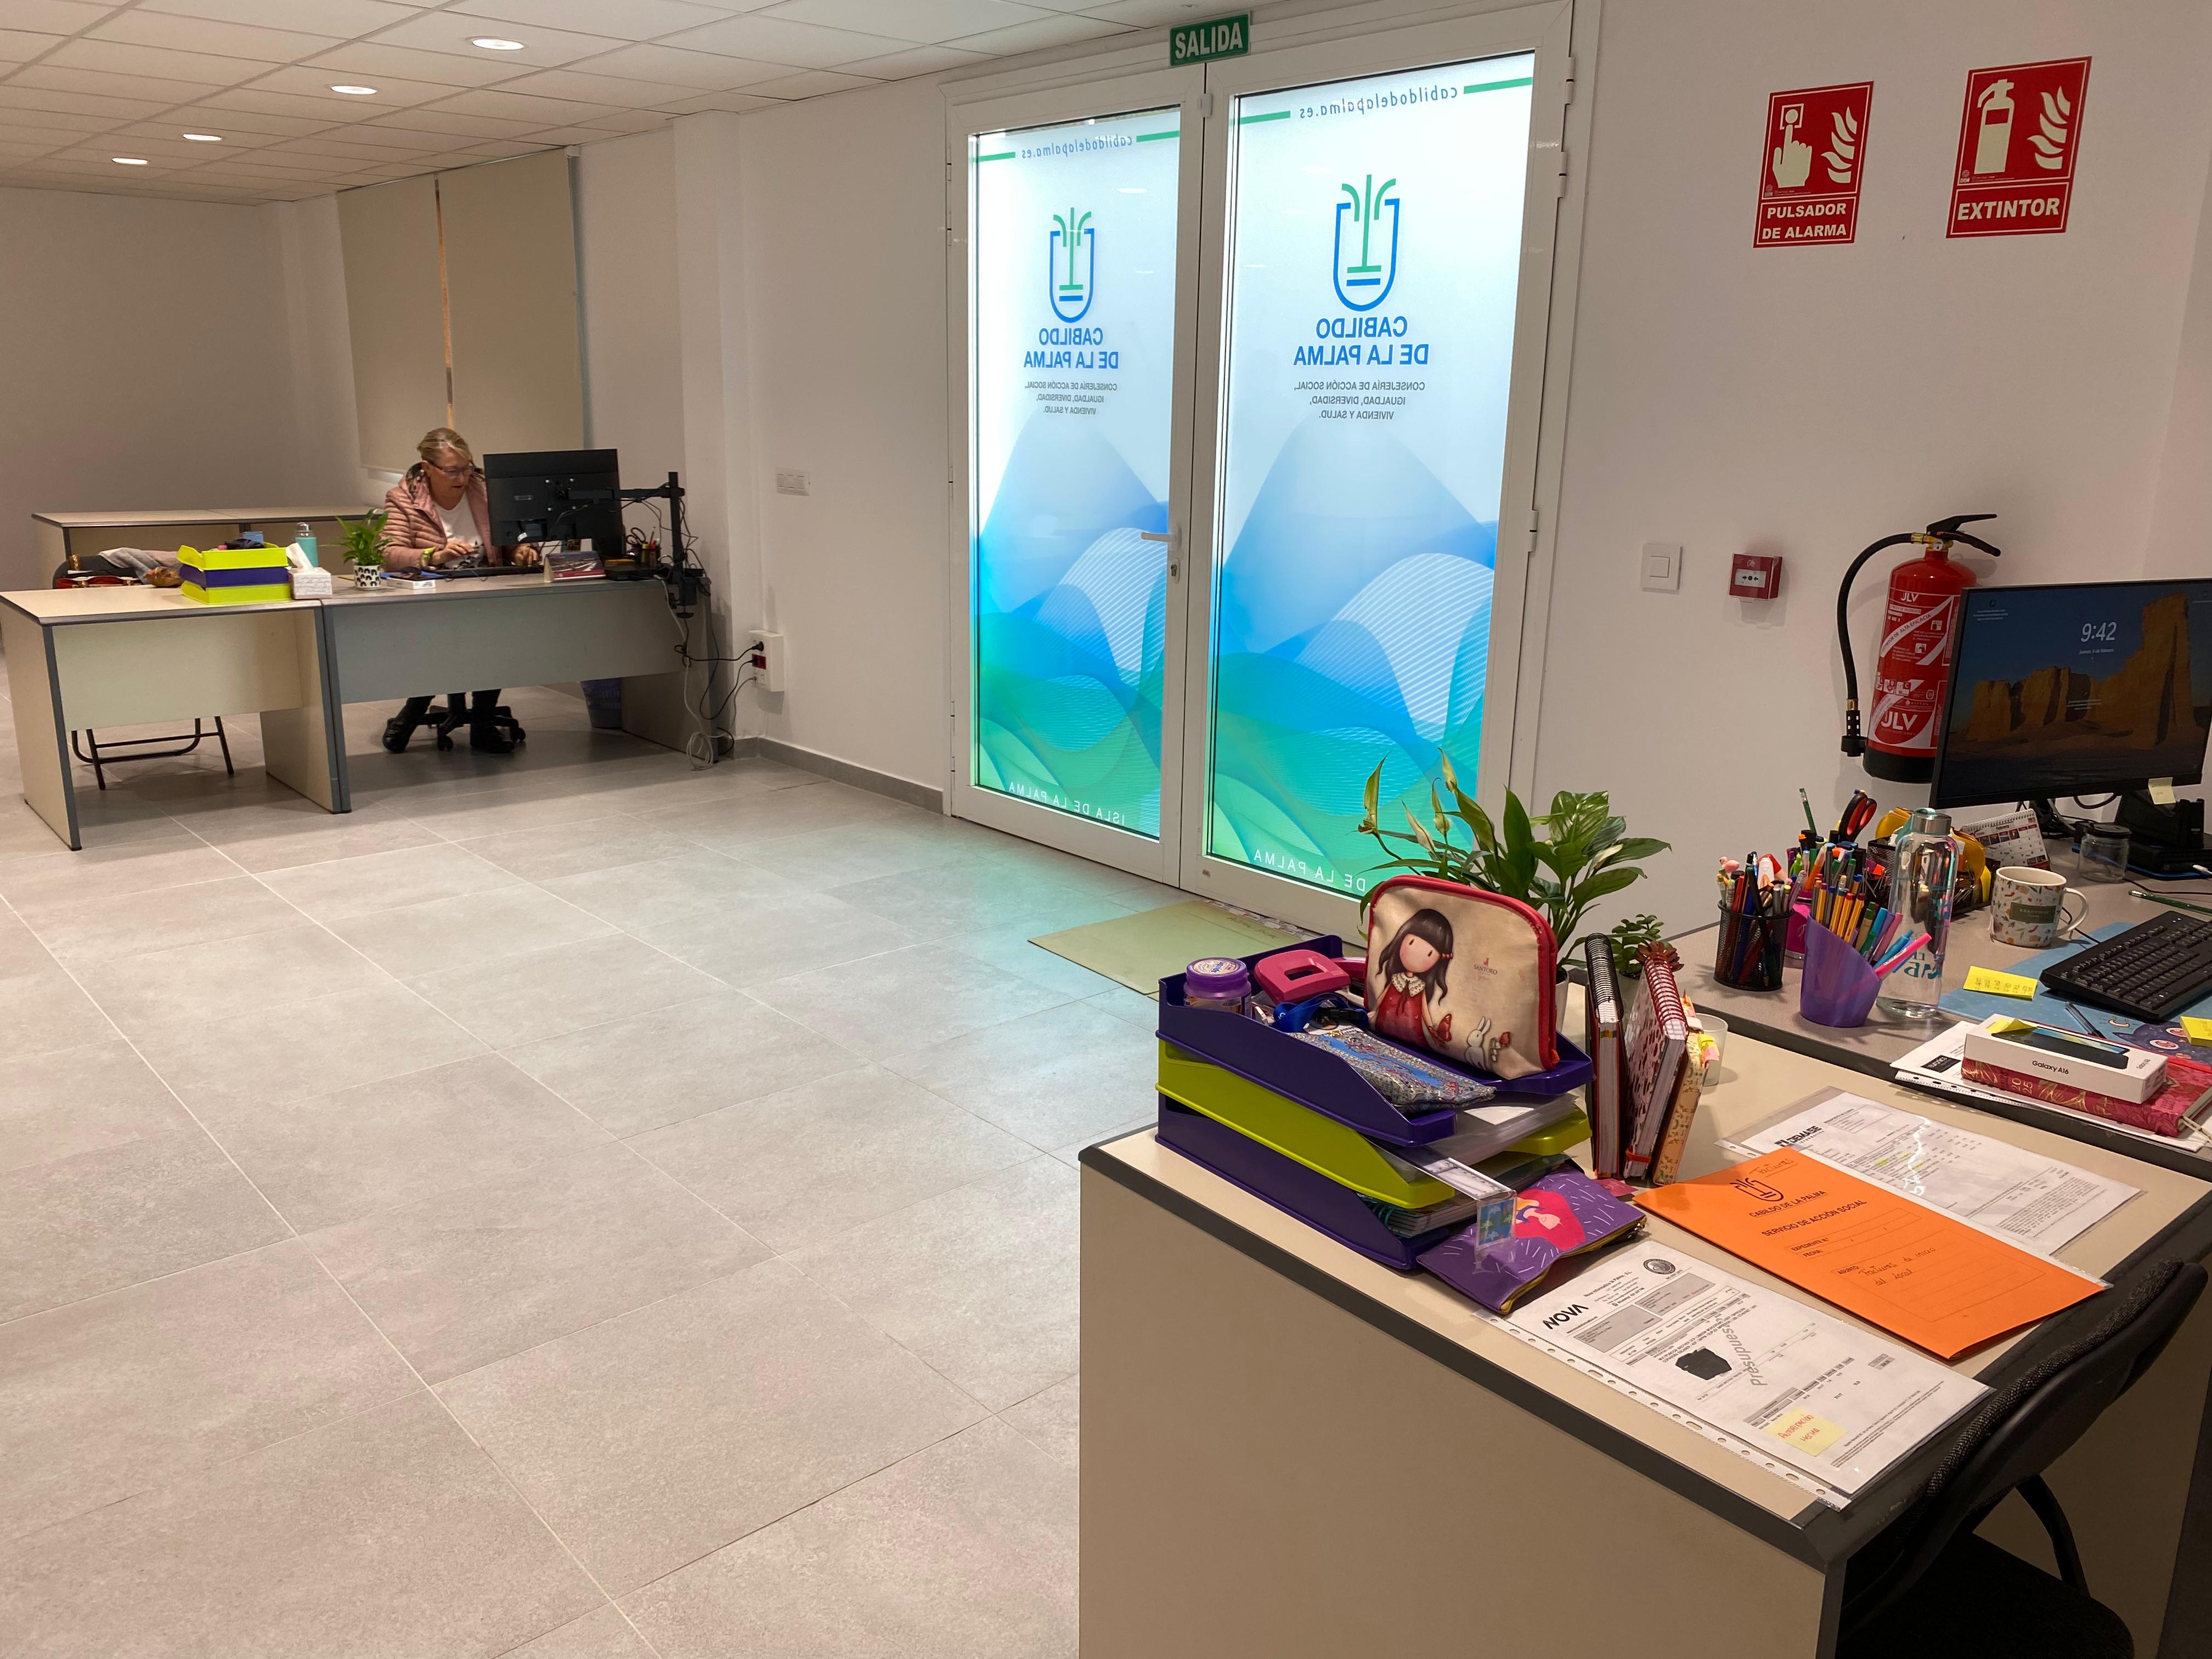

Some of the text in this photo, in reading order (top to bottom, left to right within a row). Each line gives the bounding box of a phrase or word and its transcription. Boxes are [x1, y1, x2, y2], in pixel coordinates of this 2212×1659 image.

[1175, 22, 1243, 59] SALIDA
[1767, 203, 1847, 219] PULSADOR
[1957, 198, 2059, 220] EXTINTOR
[1762, 224, 1847, 239] DE ALARMA
[1900, 592, 1919, 602] JLV
[1900, 624, 1910, 634] ALTA
[1910, 614, 1932, 627] EFICACIA
[2081, 622, 2117, 642] 9:42
[1881, 712, 1918, 731] JLV
[1474, 964, 1498, 975] SANTORO
[2032, 1060, 2057, 1073] Galaxy
[2011, 1077, 2021, 1092] 20
[2023, 1081, 2033, 1094] 25
[1787, 1125, 1822, 1143] DEMASE
[1749, 1206, 1781, 1217] CABILDO
[1801, 1190, 1827, 1201] PALMA
[1762, 1200, 1867, 1237] SERVICIO DE ACCIÓN SOCIAL
[1542, 1304, 1589, 1329] NOVA
